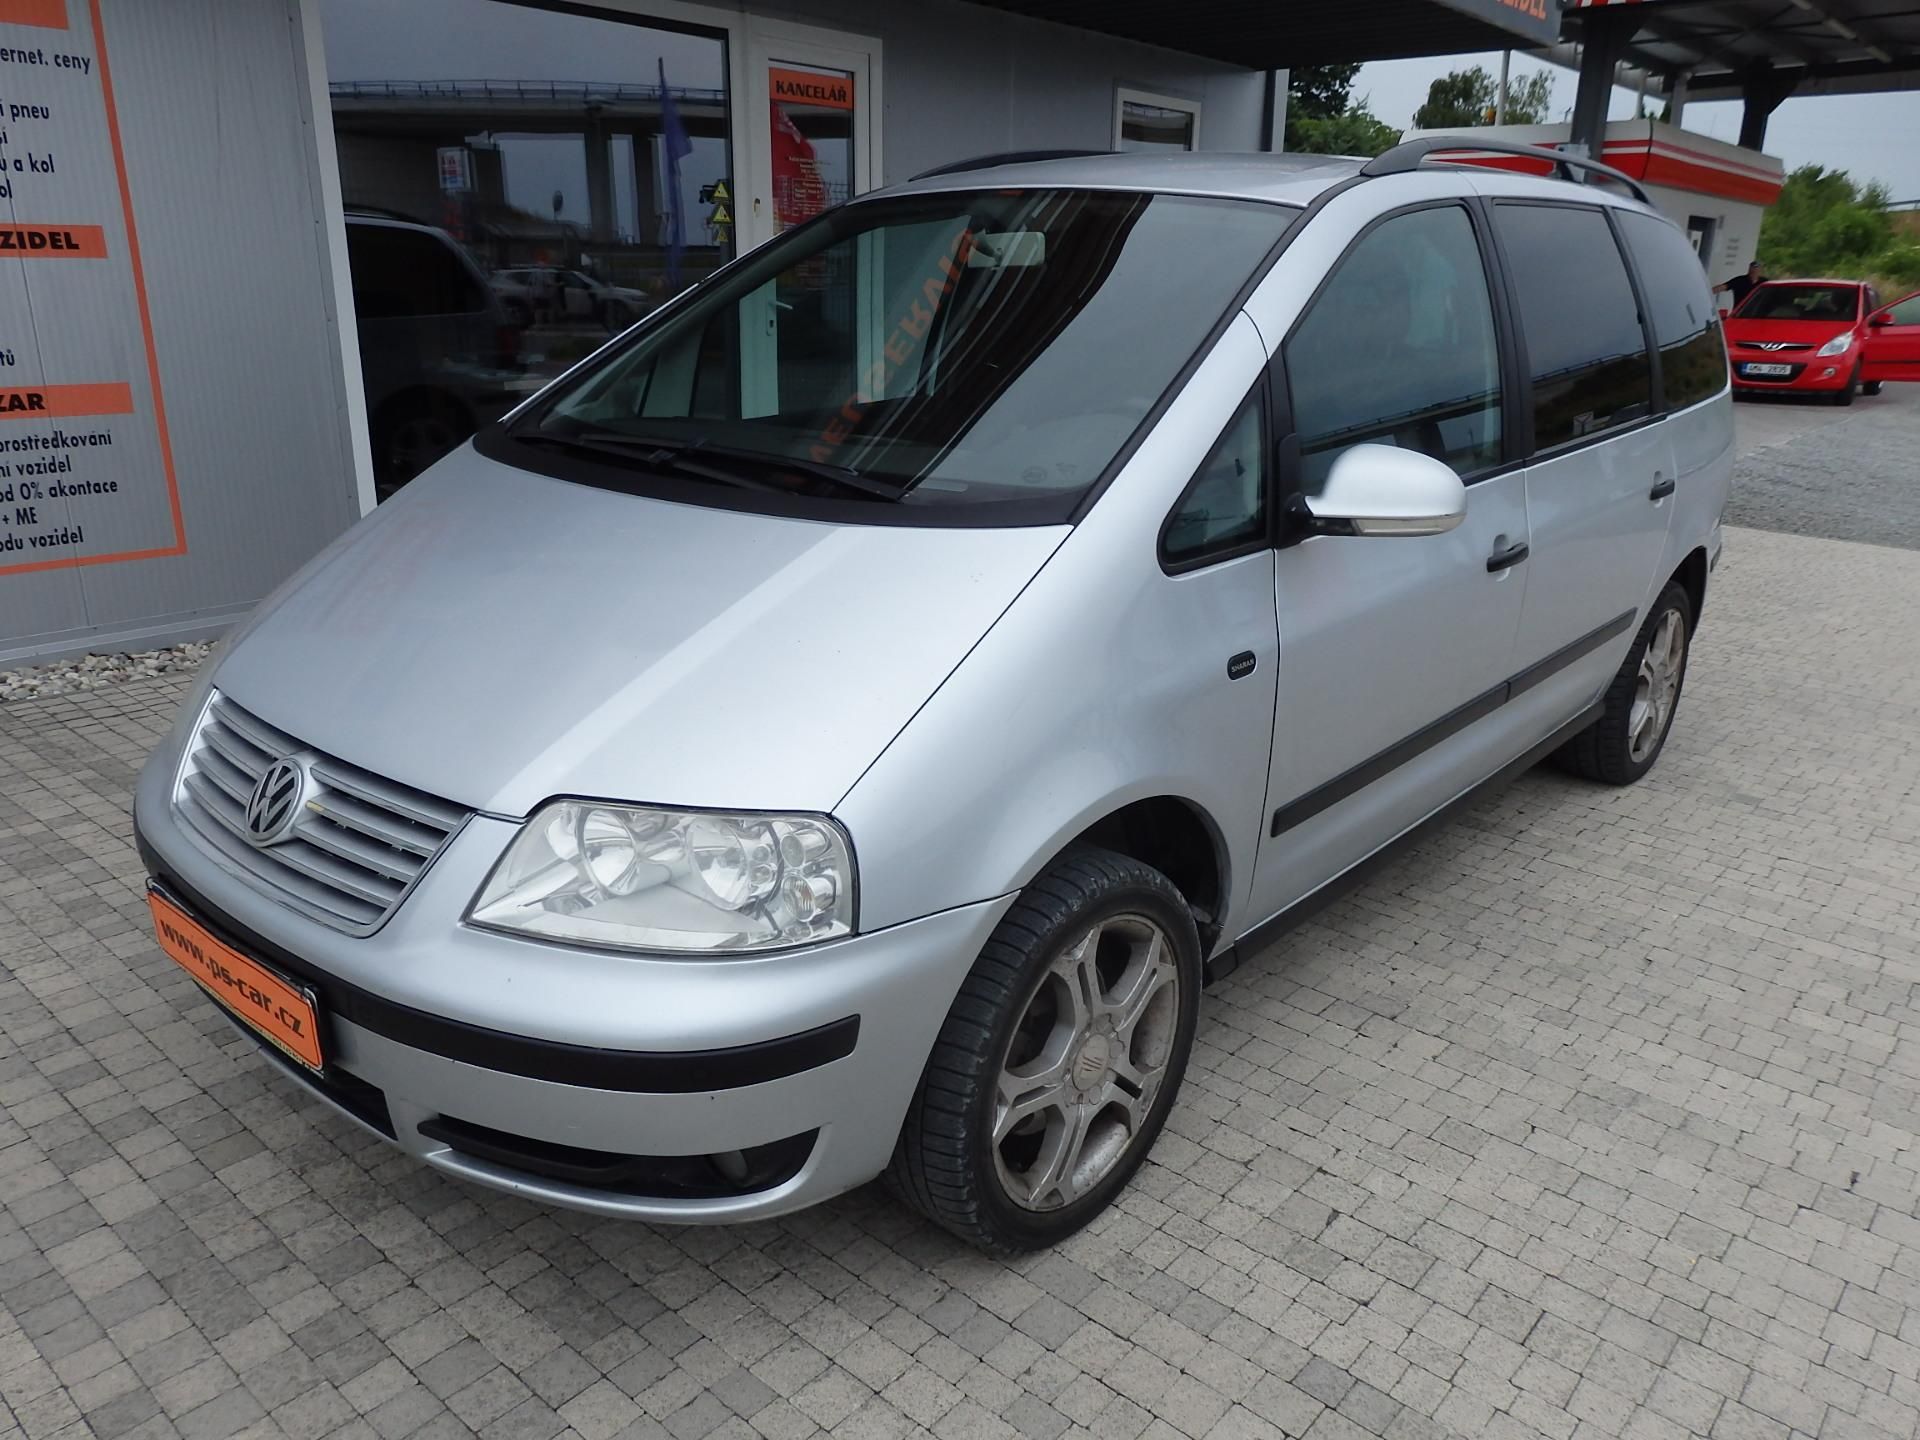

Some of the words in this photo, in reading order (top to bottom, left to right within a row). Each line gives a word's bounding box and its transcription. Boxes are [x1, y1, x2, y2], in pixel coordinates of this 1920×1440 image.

[0, 48, 49, 66] ernet.
[54, 54, 91, 75] ceny
[776, 80, 847, 102] KANCELÁŘ
[10, 104, 50, 122] pneu
[14, 159, 23, 172] a
[28, 152, 55, 173] kol
[0, 230, 80, 250] ZIDEL
[16, 454, 71, 476] vozidel
[20, 481, 43, 500] 0%
[48, 478, 118, 498] akontace
[16, 507, 38, 525] ME
[29, 526, 84, 546] vozidel
[160, 920, 304, 1038] www.ps-car.cz
